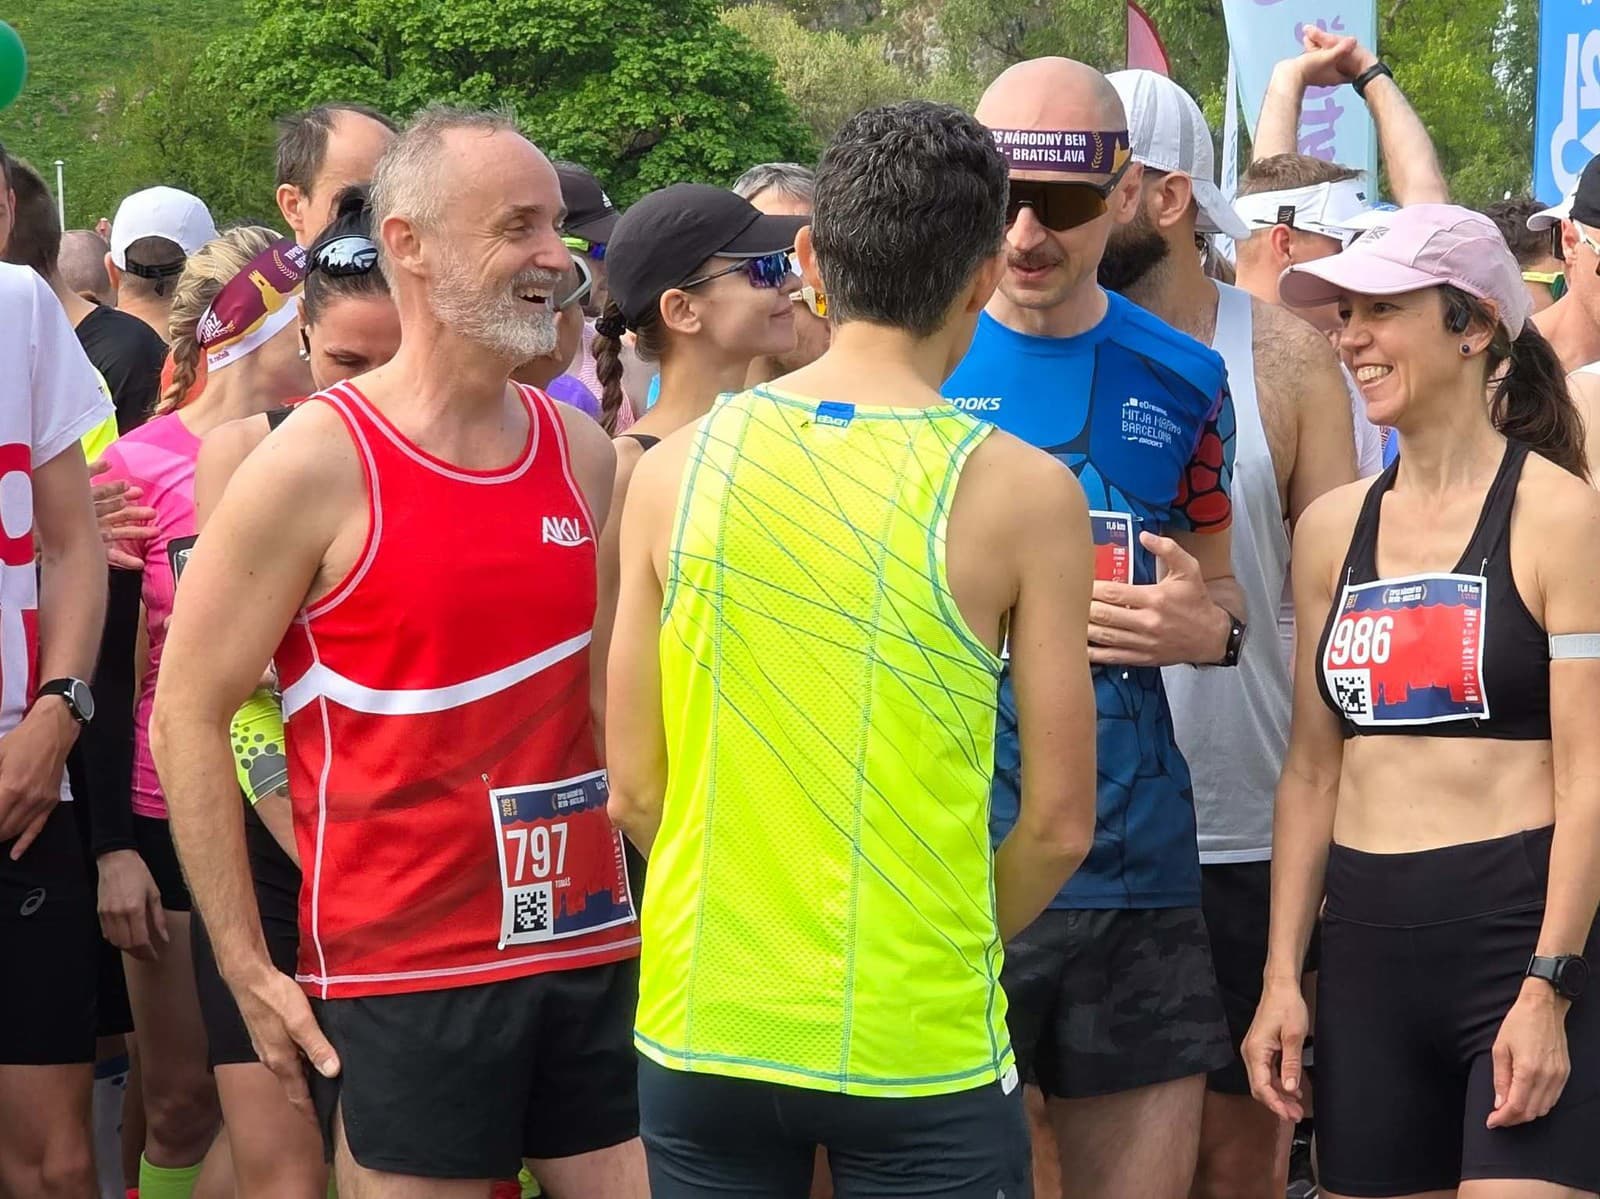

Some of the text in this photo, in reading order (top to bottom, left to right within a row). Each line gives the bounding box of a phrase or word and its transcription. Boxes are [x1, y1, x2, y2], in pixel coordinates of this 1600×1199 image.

[1004, 130, 1063, 146] NÁRODNÝ
[1065, 133, 1087, 147] BEH
[1012, 148, 1086, 163] BRATISLAVA
[1121, 420, 1172, 445] BARCELONA
[1331, 614, 1394, 666] 986
[505, 822, 568, 882] 797
